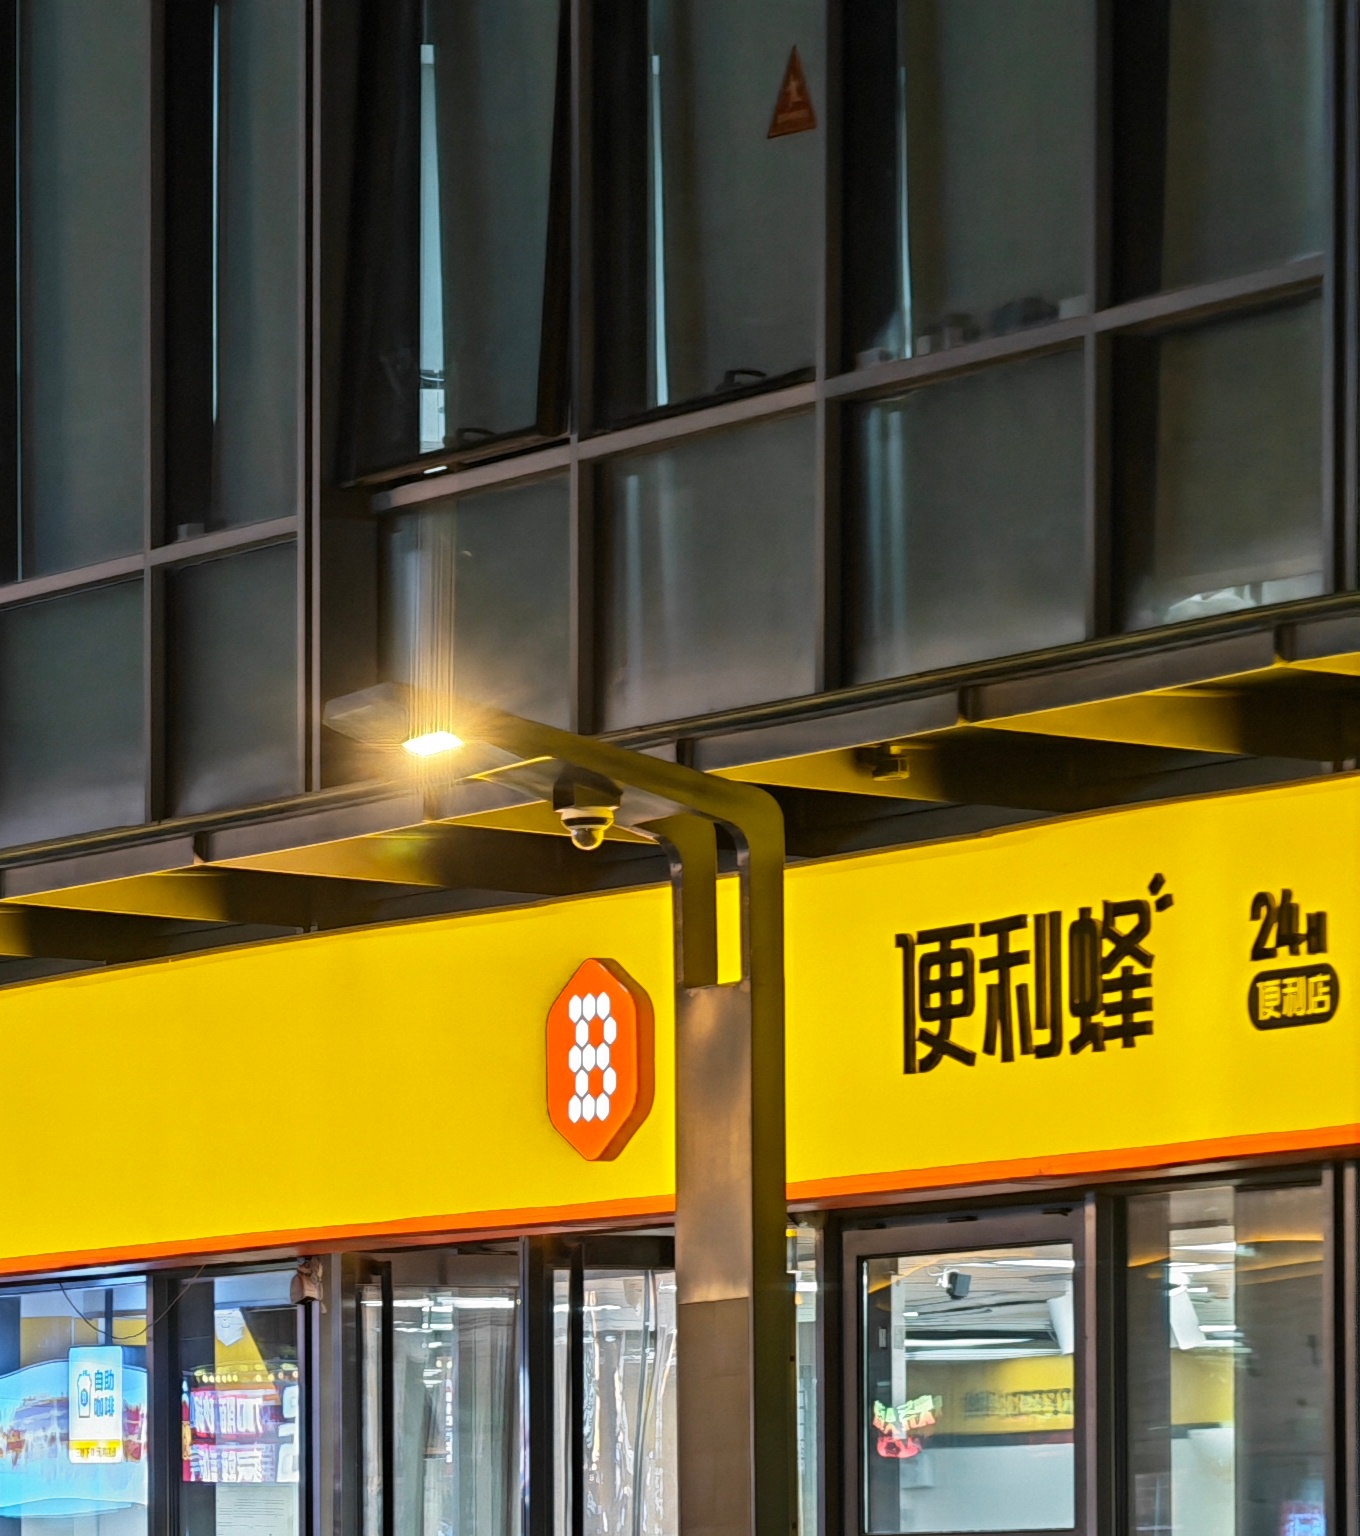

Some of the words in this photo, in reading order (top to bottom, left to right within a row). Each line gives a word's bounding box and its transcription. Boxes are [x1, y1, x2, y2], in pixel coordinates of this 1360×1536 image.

[895, 873, 1174, 1075] 便利蜂
[1256, 973, 1331, 1021] 便利店
[94, 1369, 115, 1392] 自助
[94, 1396, 115, 1418] 咖啡
